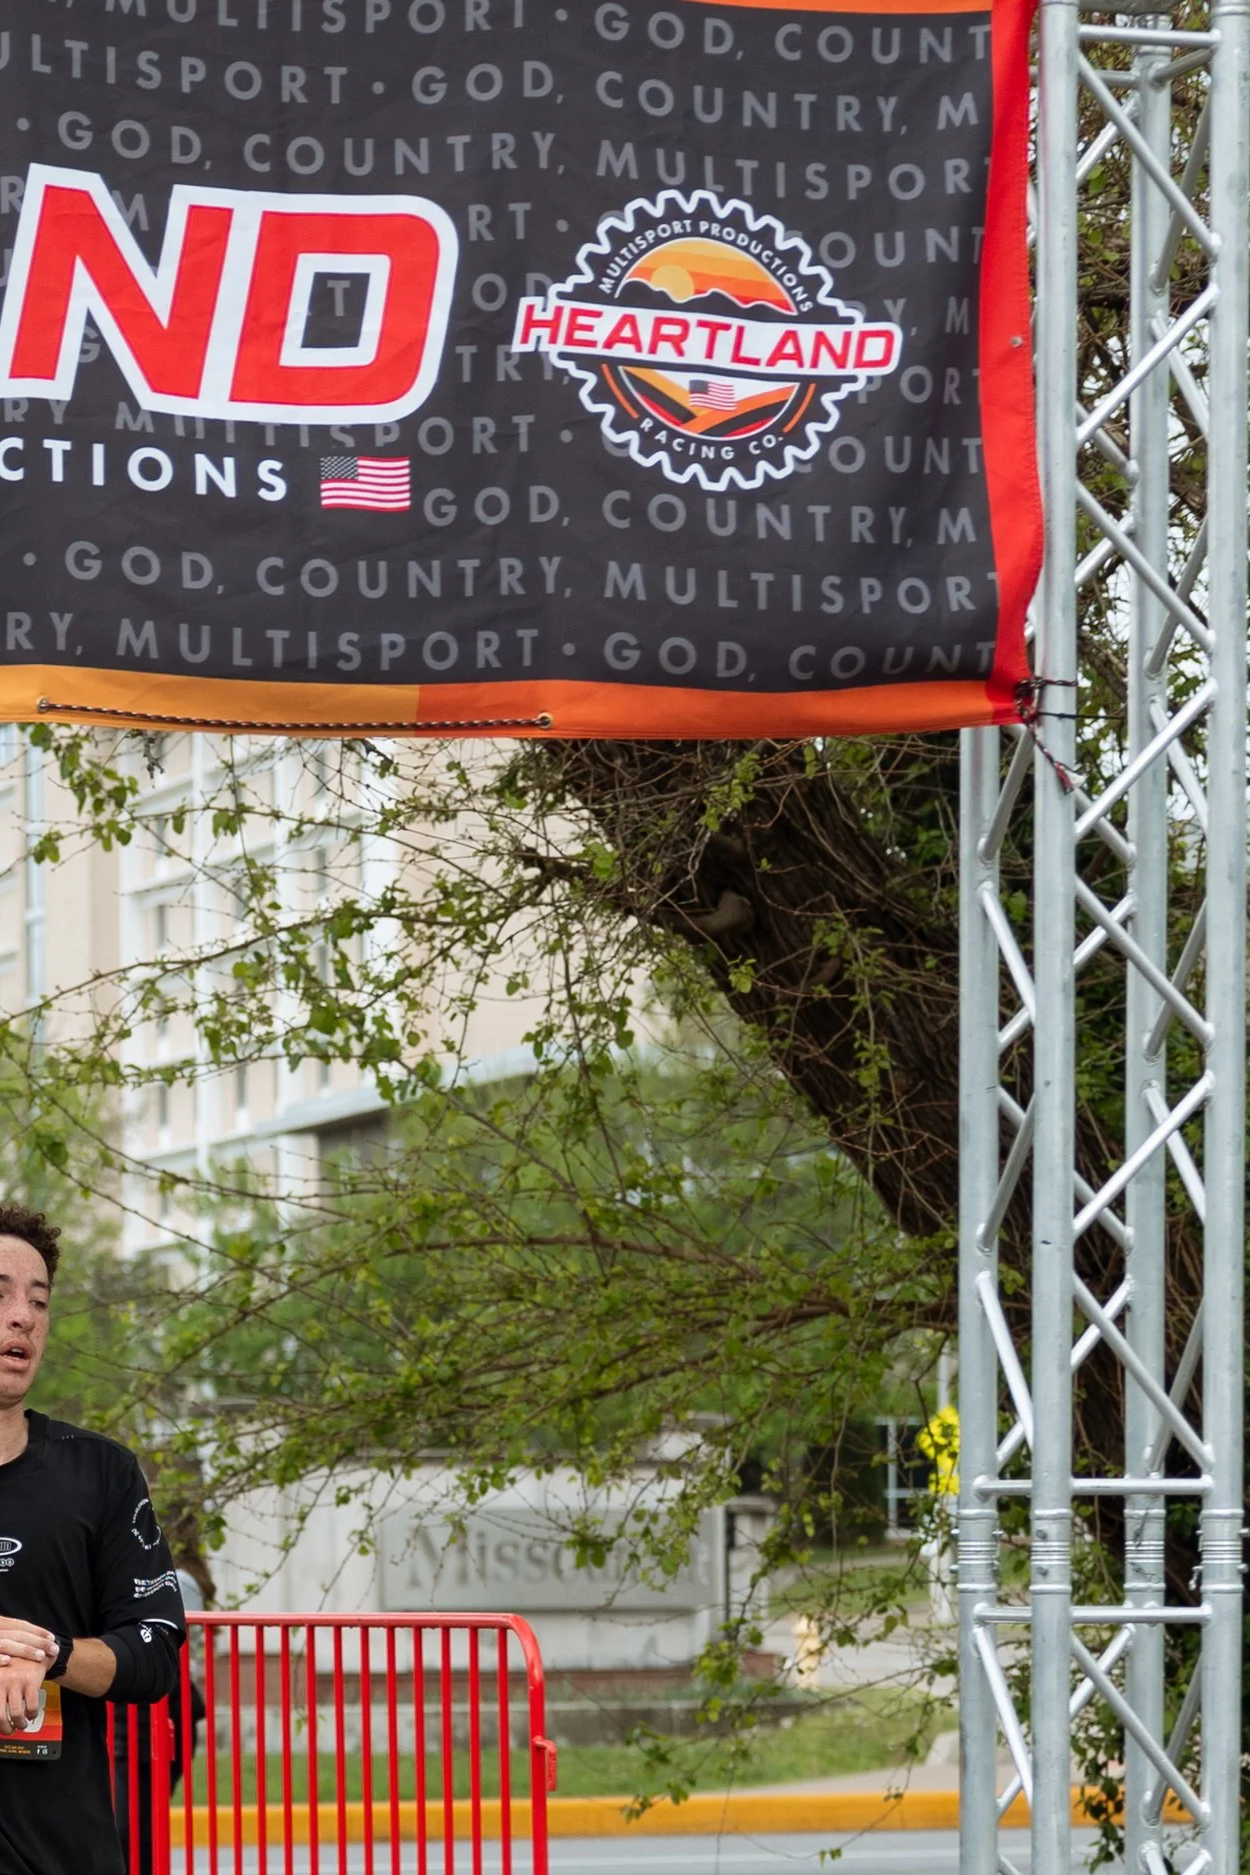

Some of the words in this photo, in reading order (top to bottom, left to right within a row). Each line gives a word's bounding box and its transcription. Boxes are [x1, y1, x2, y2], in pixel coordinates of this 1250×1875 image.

[594, 2, 743, 60] GOD,
[412, 60, 564, 105] GOD,
[595, 70, 907, 135] COUNTRY,
[58, 111, 212, 170] GOD,
[243, 131, 564, 177] COUNTRY,
[597, 140, 991, 201] MULTISPOR
[599, 218, 693, 295] MULTISPORT
[699, 219, 814, 314] PRODUCTIONS
[784, 225, 985, 270] OUNT
[520, 303, 896, 370] HEARTLAND
[640, 417, 735, 460] RACING
[793, 434, 982, 475] OUNT
[423, 485, 570, 527] GOD,
[602, 491, 913, 548] COUNTRY,
[64, 540, 224, 595] GOD,
[256, 556, 572, 599] COUNTRY,
[604, 560, 998, 614] MULTISPOR
[116, 617, 539, 671] MULTISPORT
[602, 633, 756, 684] GOD,
